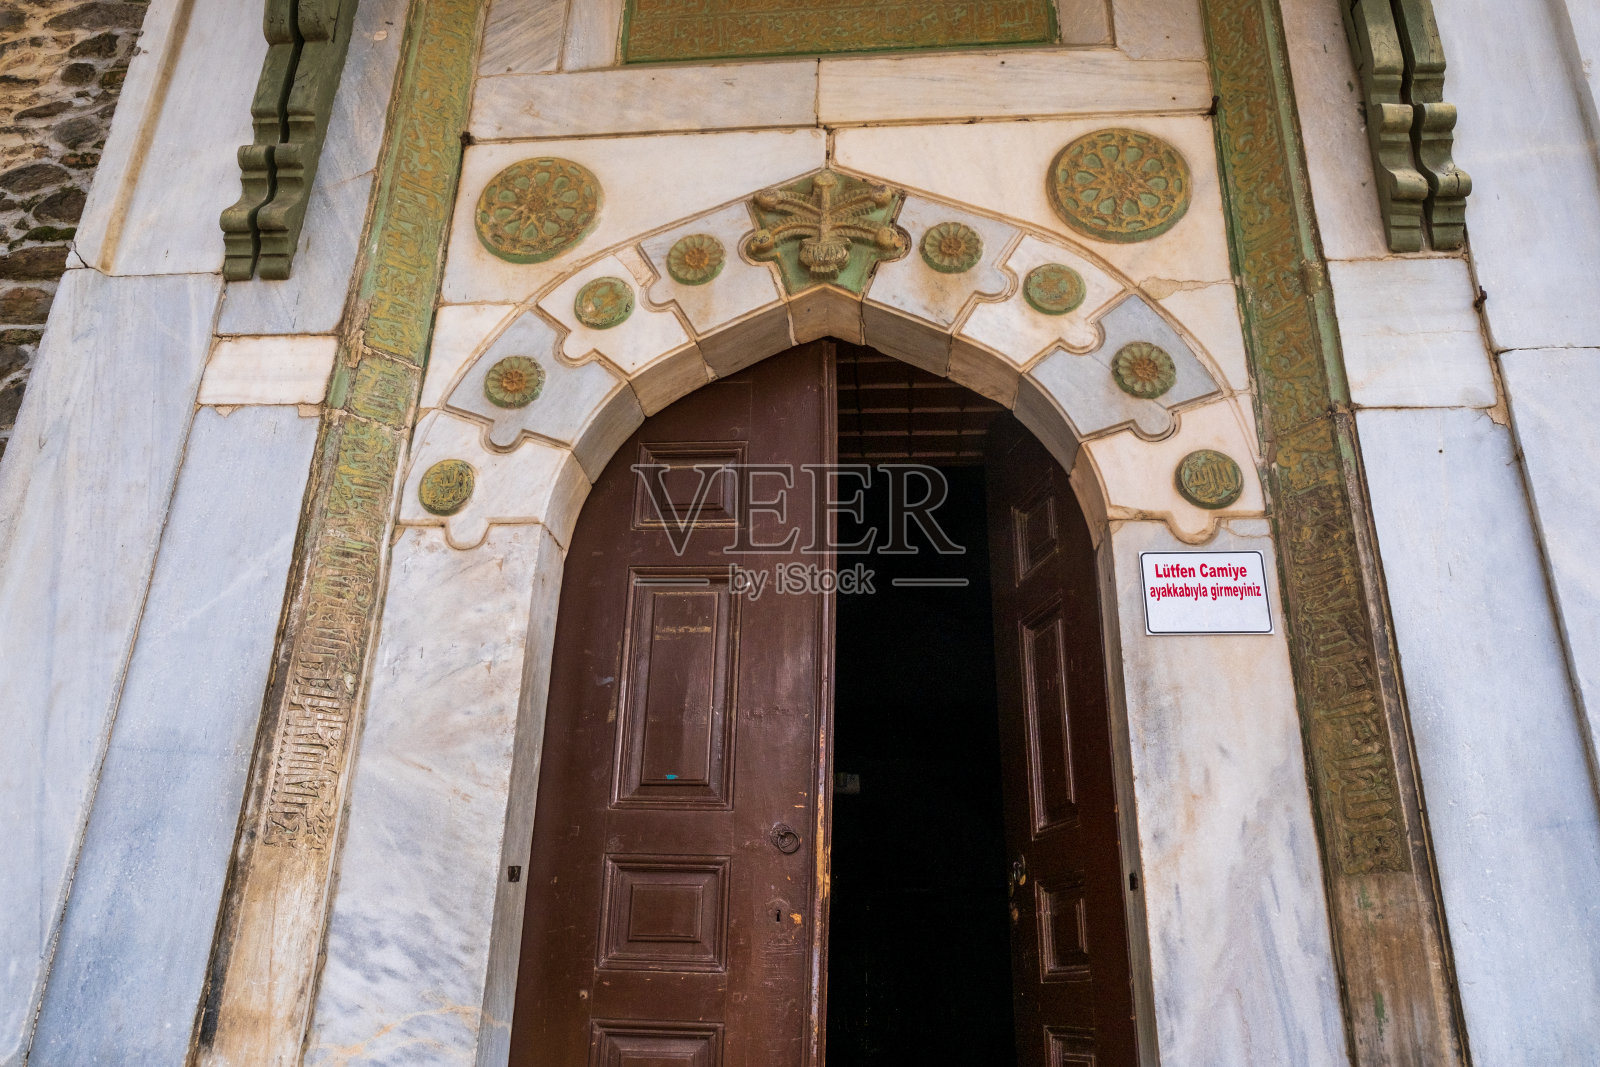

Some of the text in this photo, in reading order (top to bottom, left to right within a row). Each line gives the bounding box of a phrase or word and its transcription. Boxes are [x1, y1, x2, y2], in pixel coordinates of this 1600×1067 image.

[1154, 563, 1247, 581] Lütfen Camiye
[1150, 582, 1262, 601] ayakkabıyla girmeyiniz
